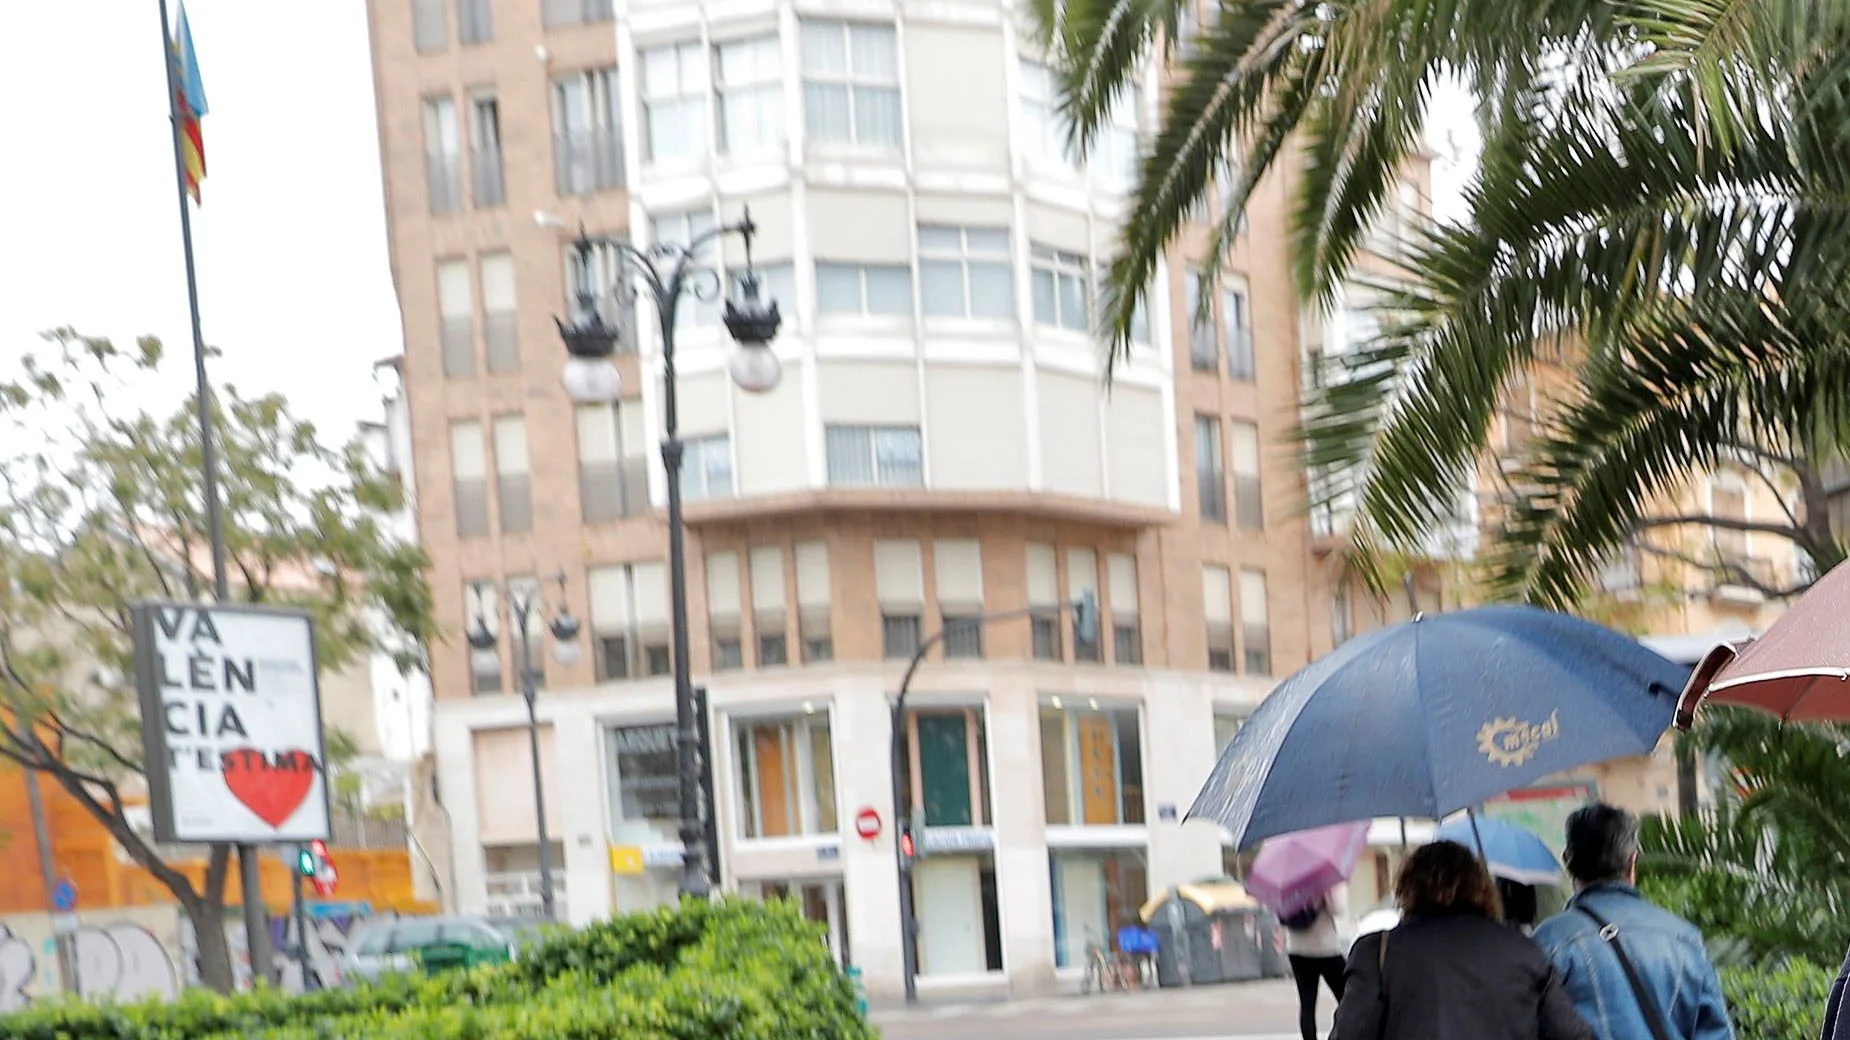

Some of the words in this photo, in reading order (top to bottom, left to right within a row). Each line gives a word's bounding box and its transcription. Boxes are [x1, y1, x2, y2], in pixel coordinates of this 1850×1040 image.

[154, 608, 222, 645] VA
[158, 648, 255, 692] LÈN
[164, 702, 248, 738] CIA
